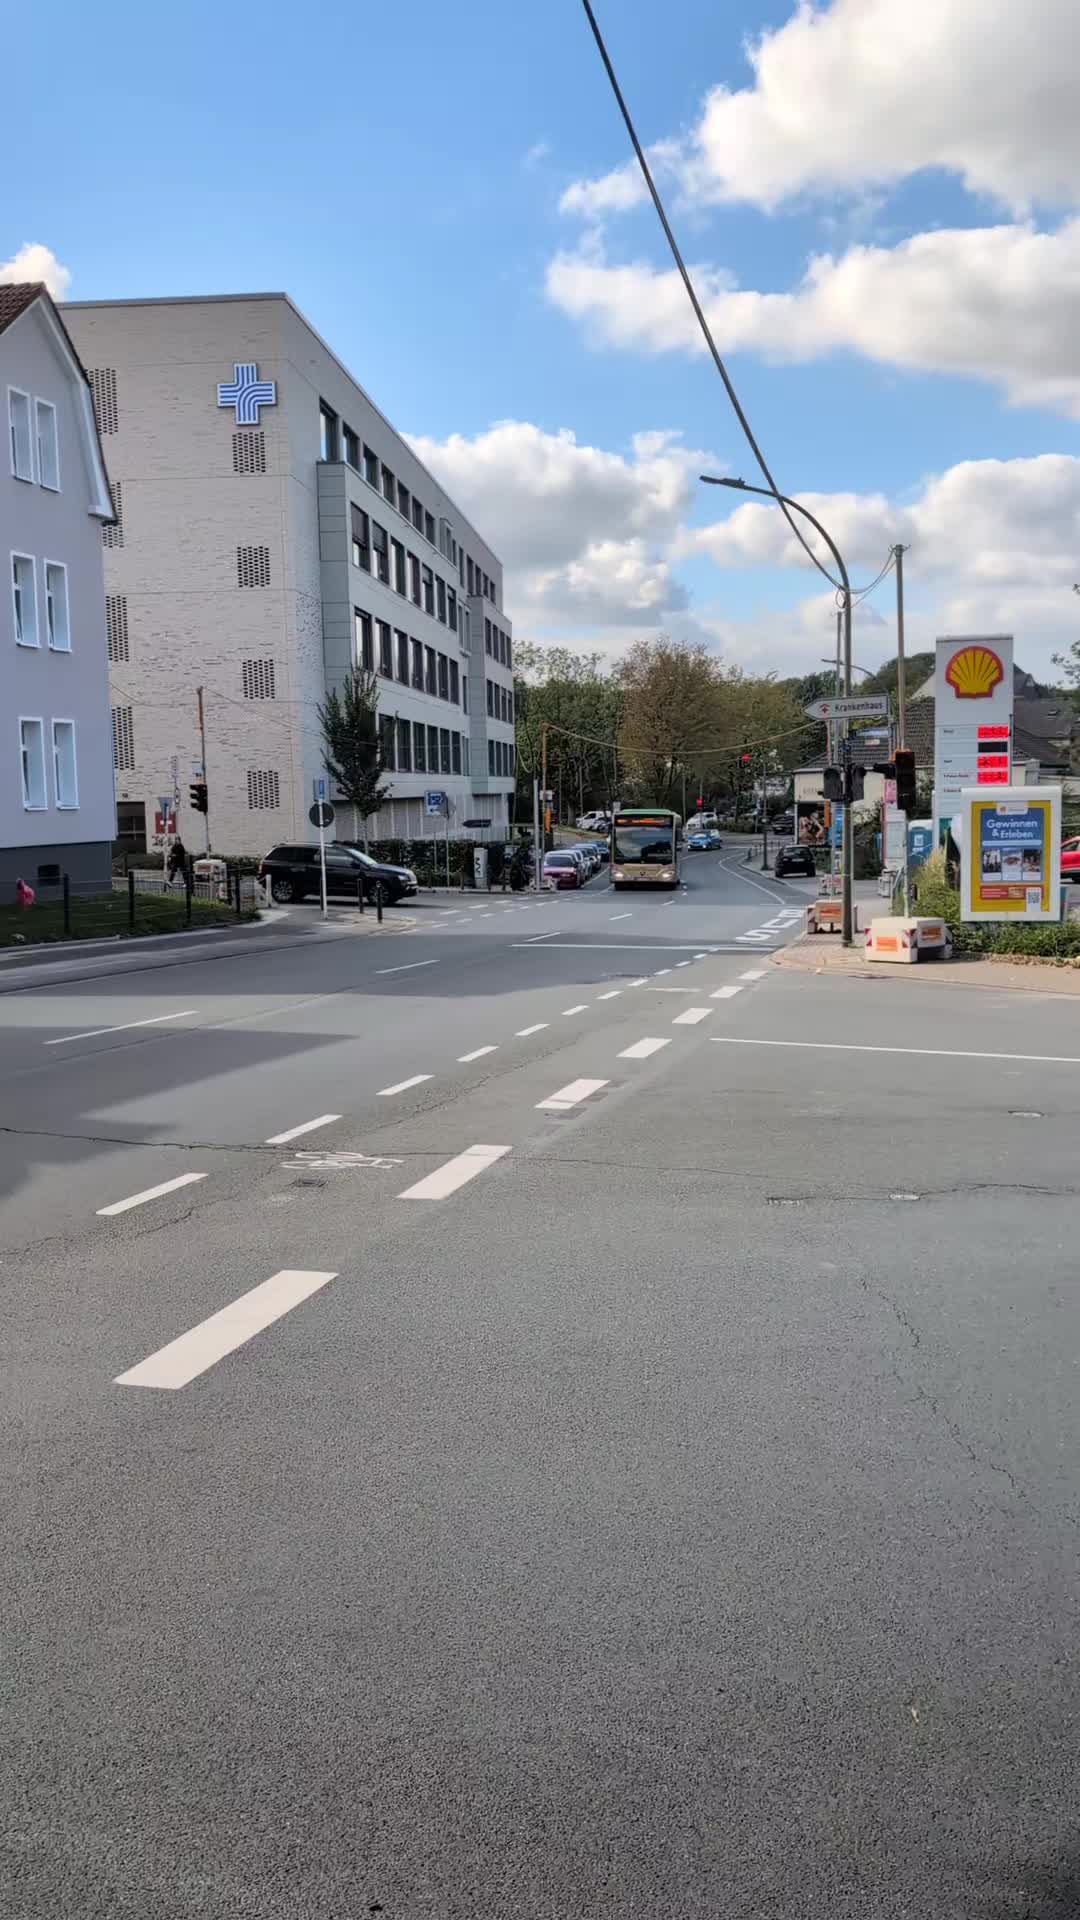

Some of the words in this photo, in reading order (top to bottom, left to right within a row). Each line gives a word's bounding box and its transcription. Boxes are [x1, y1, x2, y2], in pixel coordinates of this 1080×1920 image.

[834, 701, 883, 713] Krankenhaus
[986, 818, 1038, 829] Gewinnen
[992, 828, 999, 837] &
[1000, 829, 1034, 839] Erleben
[735, 909, 805, 941] BUS
